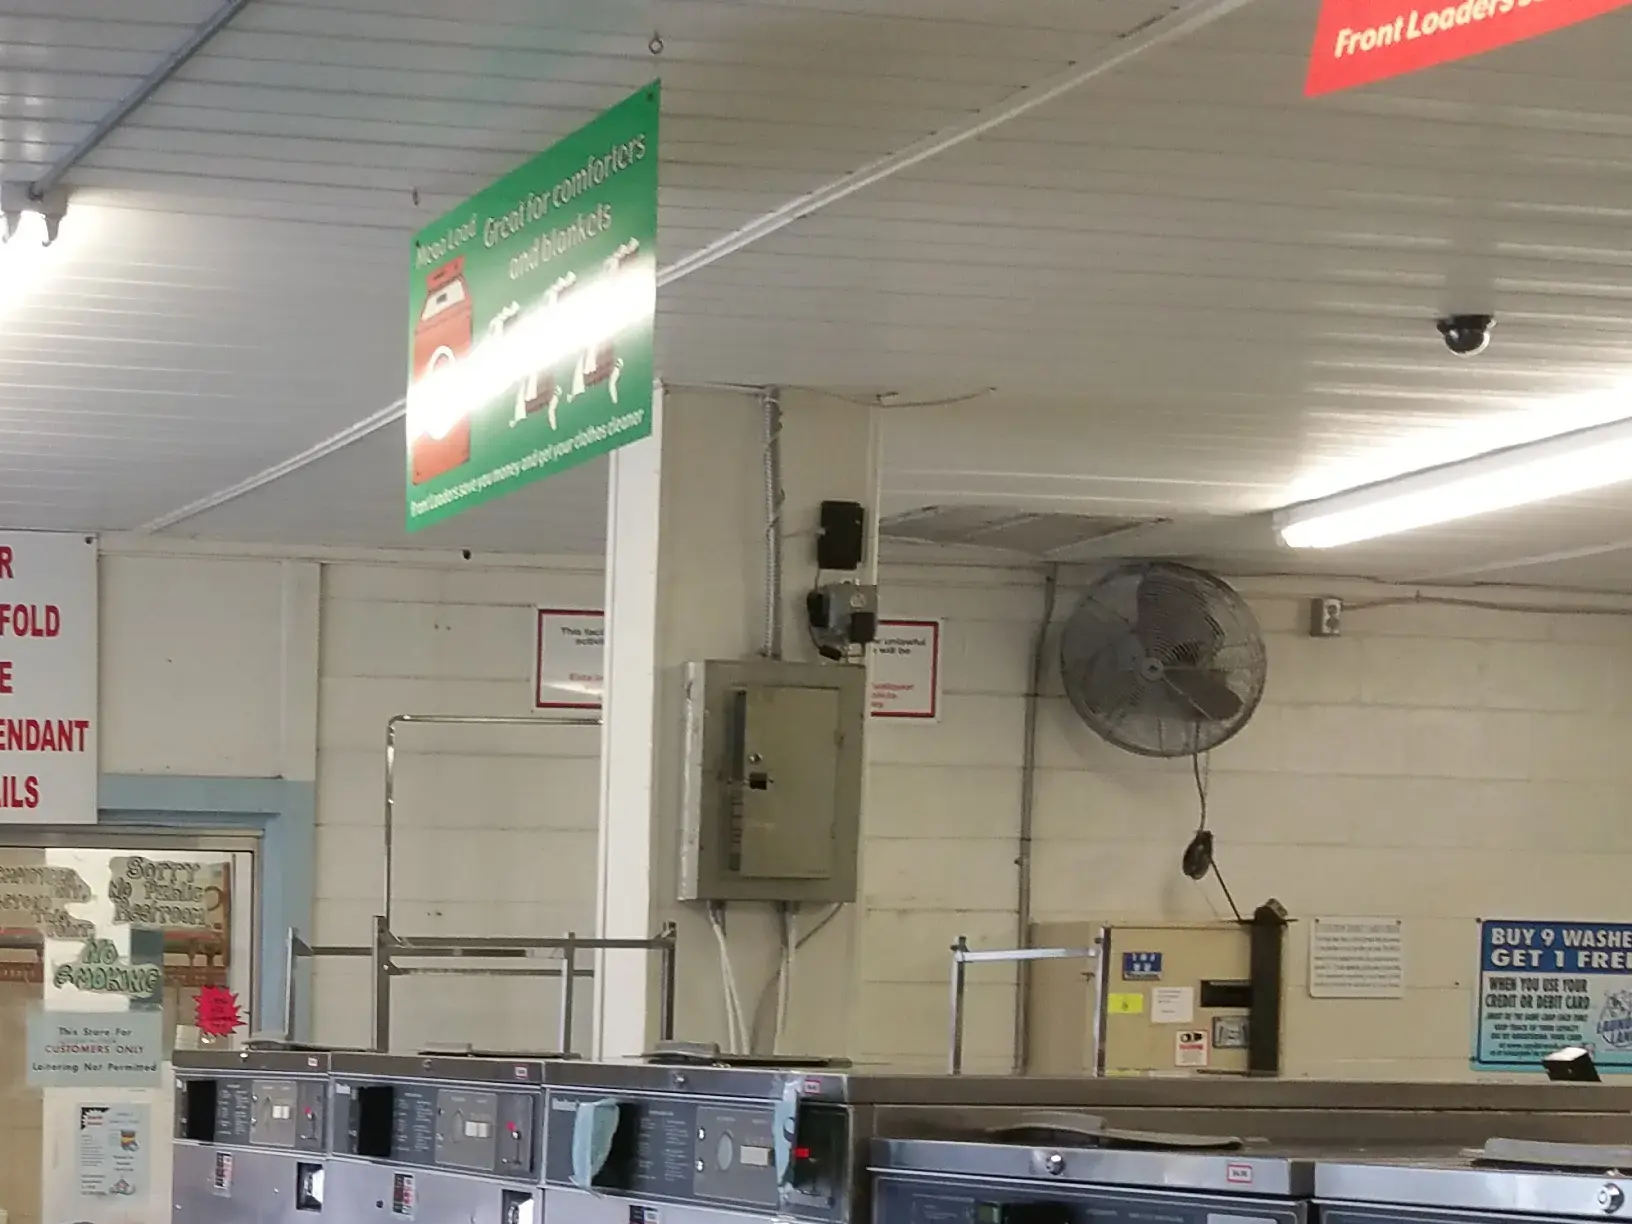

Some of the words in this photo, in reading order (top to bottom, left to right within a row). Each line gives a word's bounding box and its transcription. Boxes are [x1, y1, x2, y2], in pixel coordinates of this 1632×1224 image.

[1333, 15, 1404, 58] Front
[483, 200, 527, 248] Great
[525, 191, 553, 223] for
[552, 133, 646, 208] comforters
[508, 236, 540, 281] and
[541, 203, 612, 263] blankets
[126, 856, 201, 883] Sorry
[108, 877, 133, 900] No
[143, 880, 203, 902] Public
[1492, 928, 1535, 946] BUY
[1541, 928, 1555, 946] 9
[82, 939, 118, 965] NO
[1491, 948, 1543, 967] GET
[1554, 950, 1564, 968] 1
[53, 964, 161, 993] SMOKING
[1489, 977, 1517, 991] WHEN
[1520, 977, 1539, 992] YOU
[1542, 978, 1560, 992] USE
[1563, 979, 1588, 992] YOUR
[1485, 994, 1516, 1008] CREDIT
[1520, 994, 1534, 1009] OR
[1537, 995, 1562, 1009] DEBIT
[1565, 995, 1590, 1009] CARD
[58, 1027, 78, 1036] This
[83, 1027, 110, 1036] Store
[115, 1028, 132, 1036] For
[45, 1045, 110, 1054] CUSTOMERS
[116, 1045, 144, 1054] ONLY
[32, 1063, 79, 1073] Loitering
[84, 1063, 103, 1071] Not
[108, 1063, 157, 1072] Permitted
